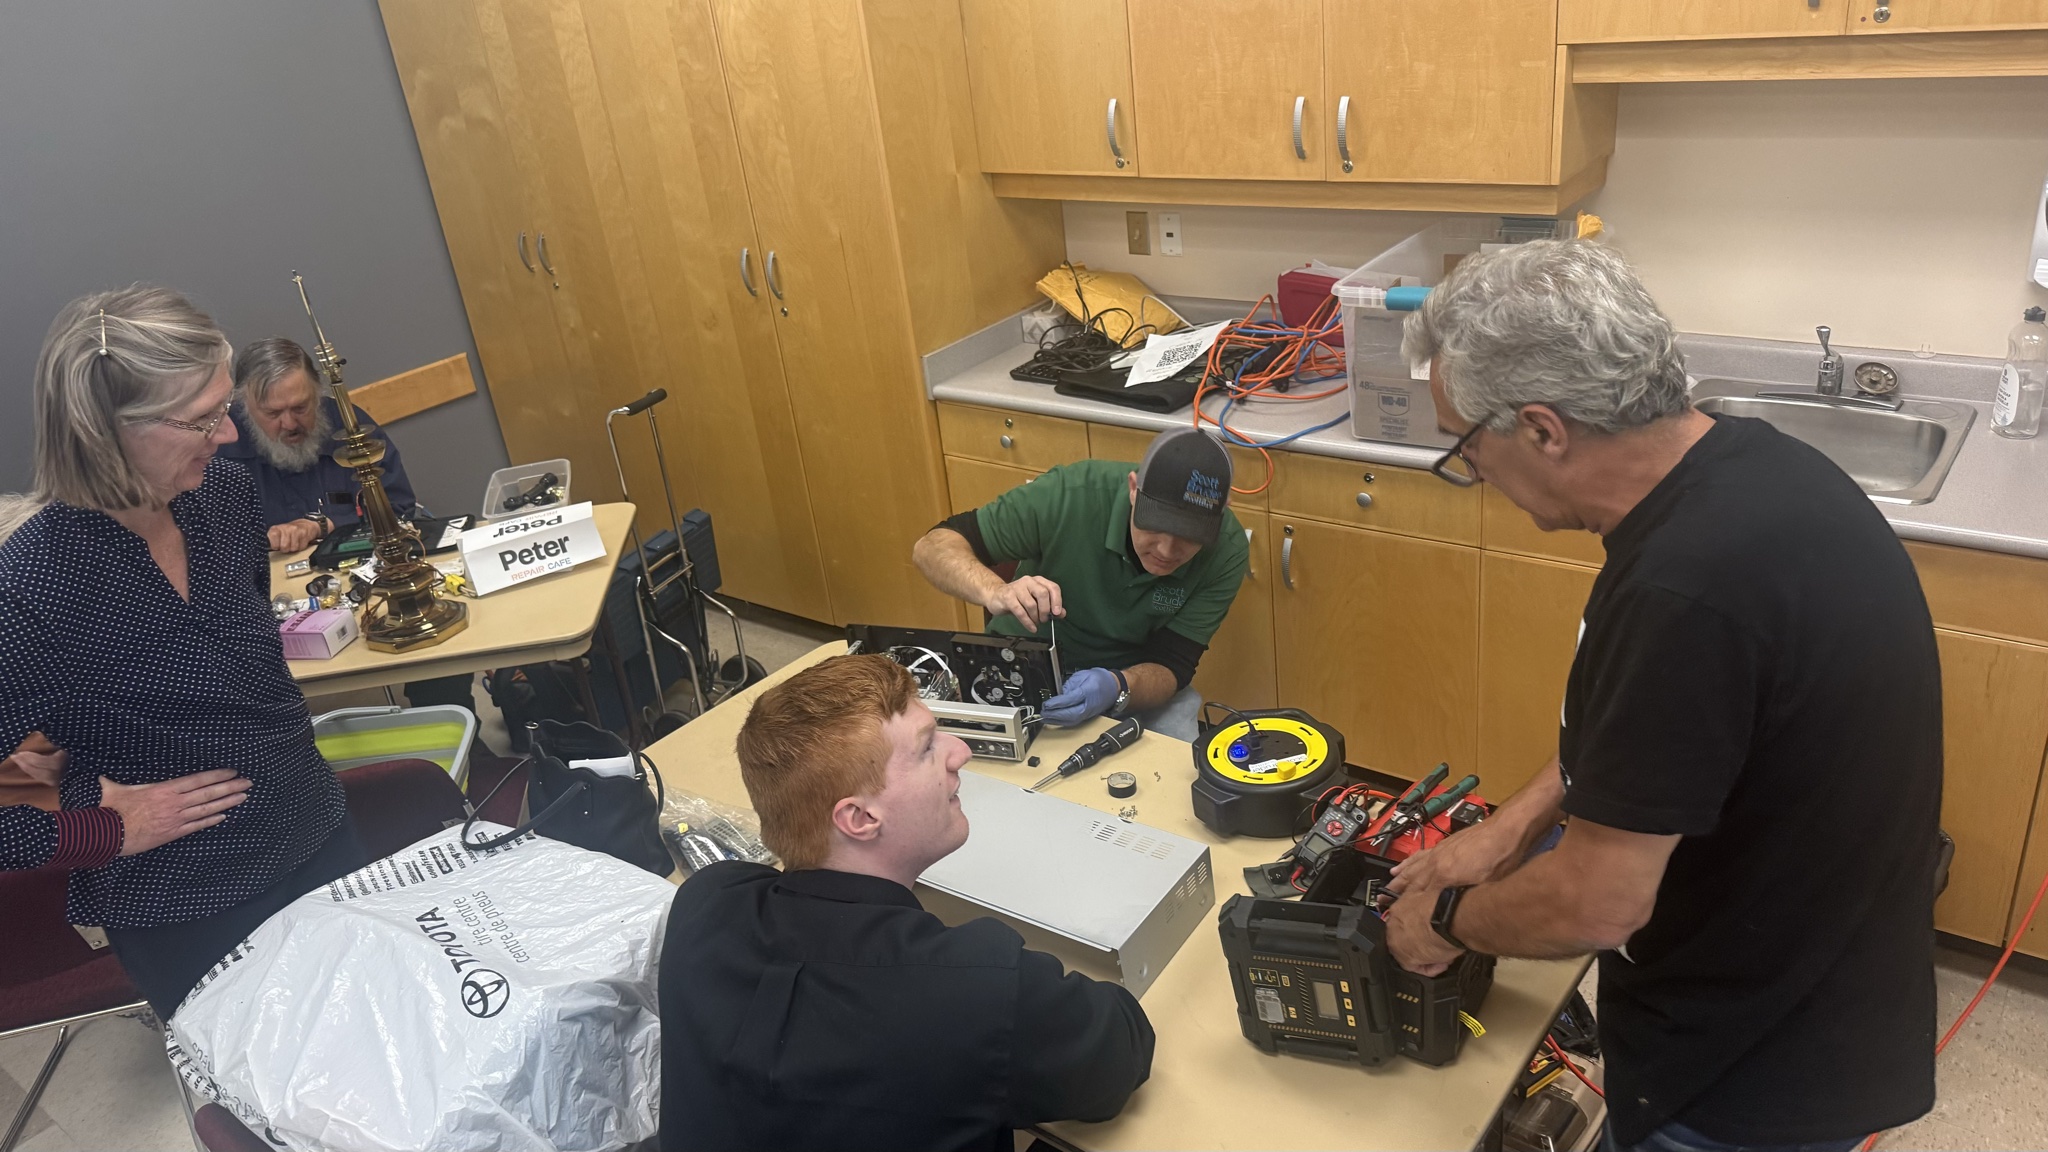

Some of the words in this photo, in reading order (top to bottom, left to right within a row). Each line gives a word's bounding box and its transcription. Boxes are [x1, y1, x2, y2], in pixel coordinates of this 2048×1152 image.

[1381, 395, 1407, 407] WD-40
[1191, 469, 1219, 490] Scott
[493, 514, 563, 538] Peter
[498, 535, 570, 572] Peter
[511, 565, 545, 582] REPAIR
[547, 557, 572, 570] CAFE
[1152, 591, 1186, 606] Brude
[1155, 584, 1185, 598] Scott
[375, 860, 395, 890] Firestone
[417, 850, 438, 879] GOODYEAR
[453, 896, 481, 927] centre
[472, 890, 504, 920] pneus
[472, 927, 493, 946] tire
[491, 919, 509, 932] de
[415, 906, 481, 974] TOYOTA
[500, 932, 531, 964] centre
